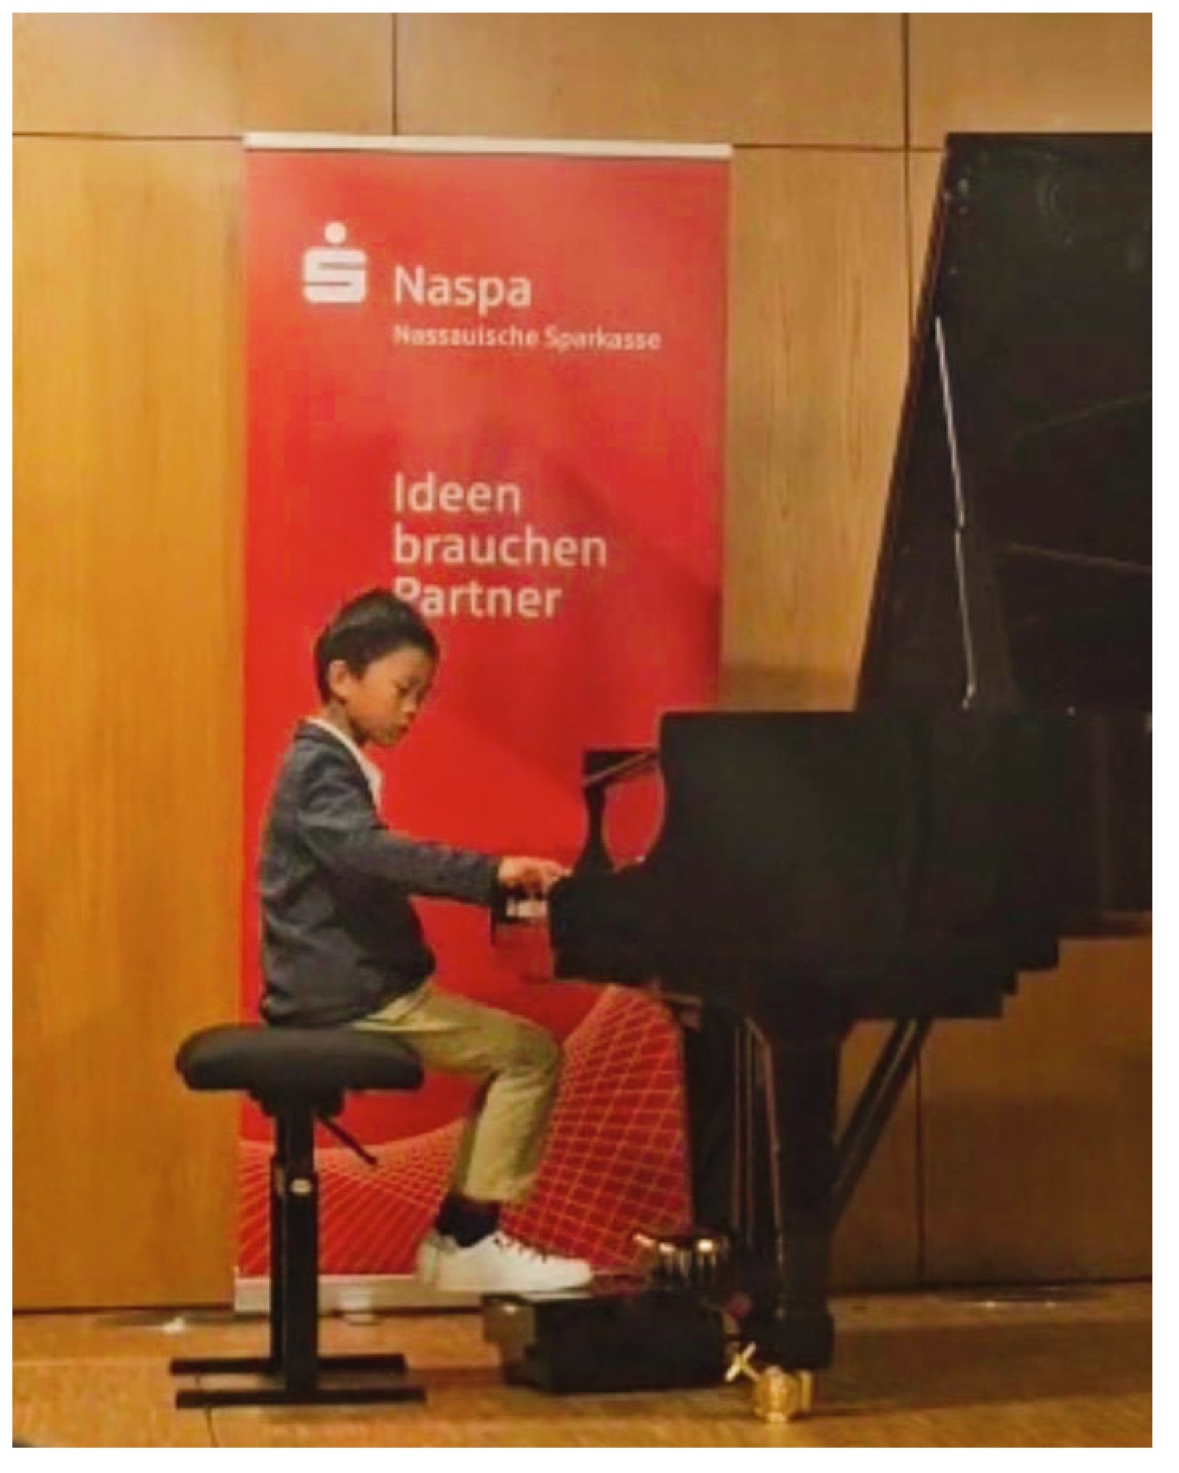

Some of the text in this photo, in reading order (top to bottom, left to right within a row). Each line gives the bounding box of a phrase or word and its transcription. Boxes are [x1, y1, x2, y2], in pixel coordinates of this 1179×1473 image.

[393, 265, 532, 316] Naspa
[392, 324, 661, 352] Nassauische Sparkasse
[393, 472, 522, 514] Ideen
[393, 523, 606, 568] brauchen
[393, 577, 562, 618] Partner
